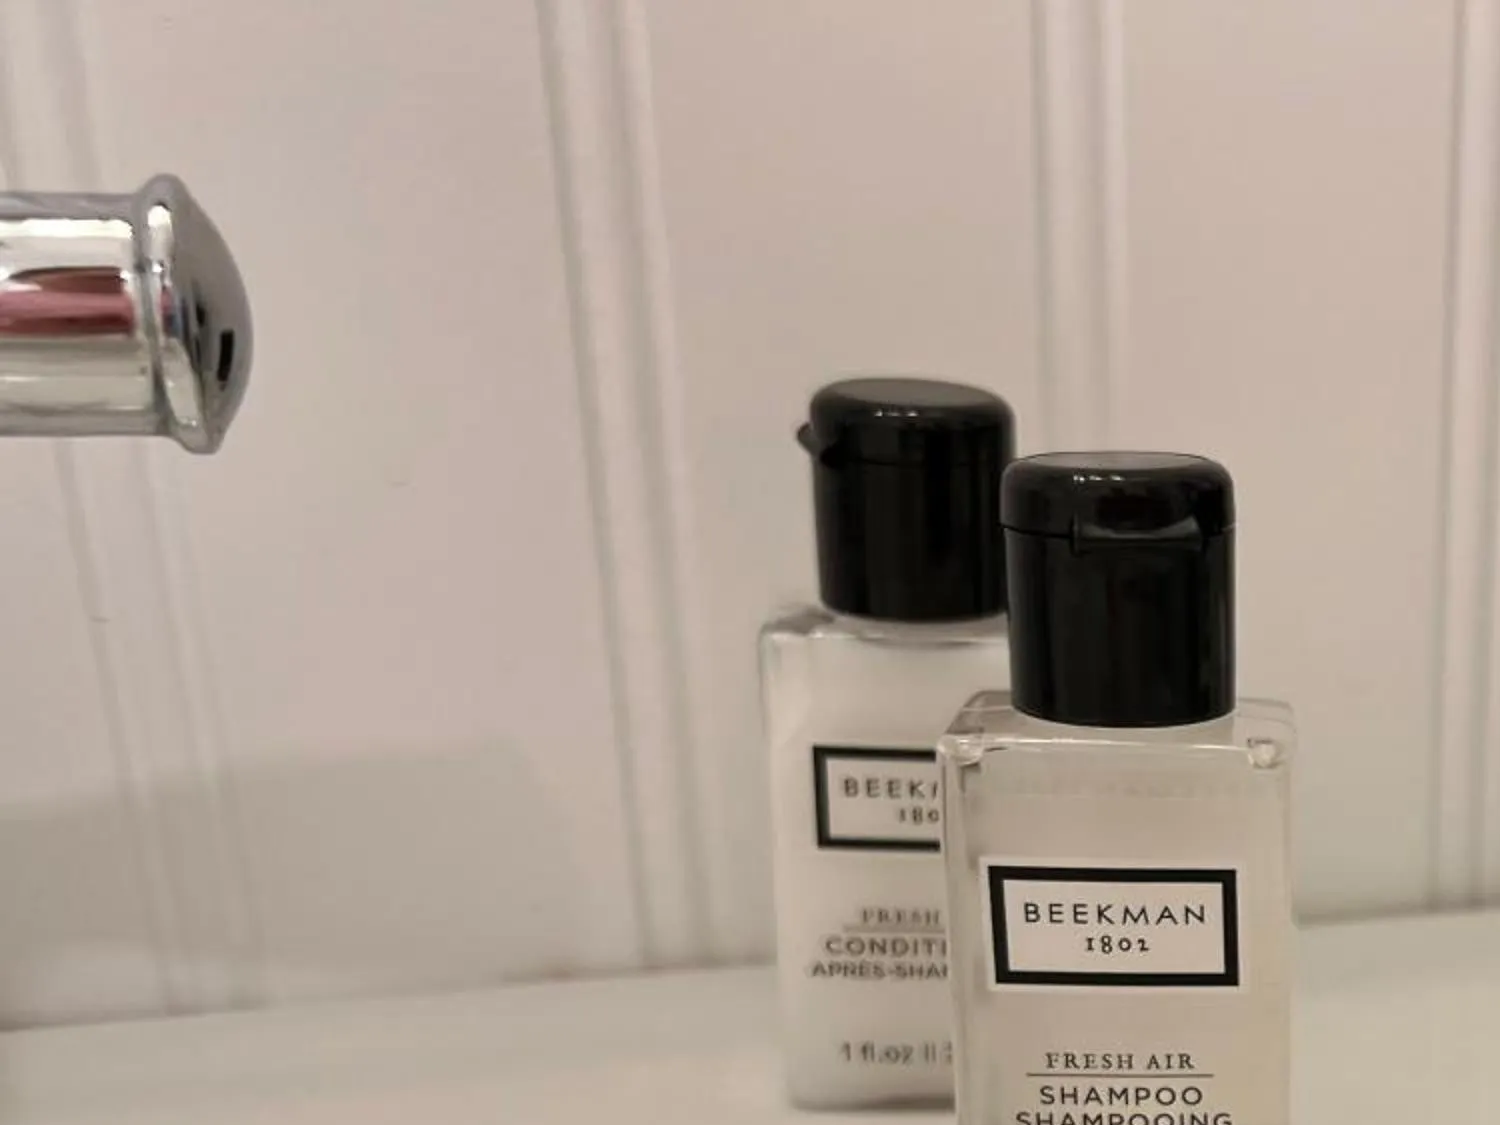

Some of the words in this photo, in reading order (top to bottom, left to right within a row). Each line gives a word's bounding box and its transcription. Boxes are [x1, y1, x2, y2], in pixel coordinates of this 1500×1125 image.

[1023, 902, 1206, 925] BEEKMAN
[1086, 935, 1150, 955] 1802
[1046, 1052, 1134, 1071] FRESH
[1146, 1052, 1195, 1070] AIR
[1040, 1086, 1203, 1107] SHAMPOO
